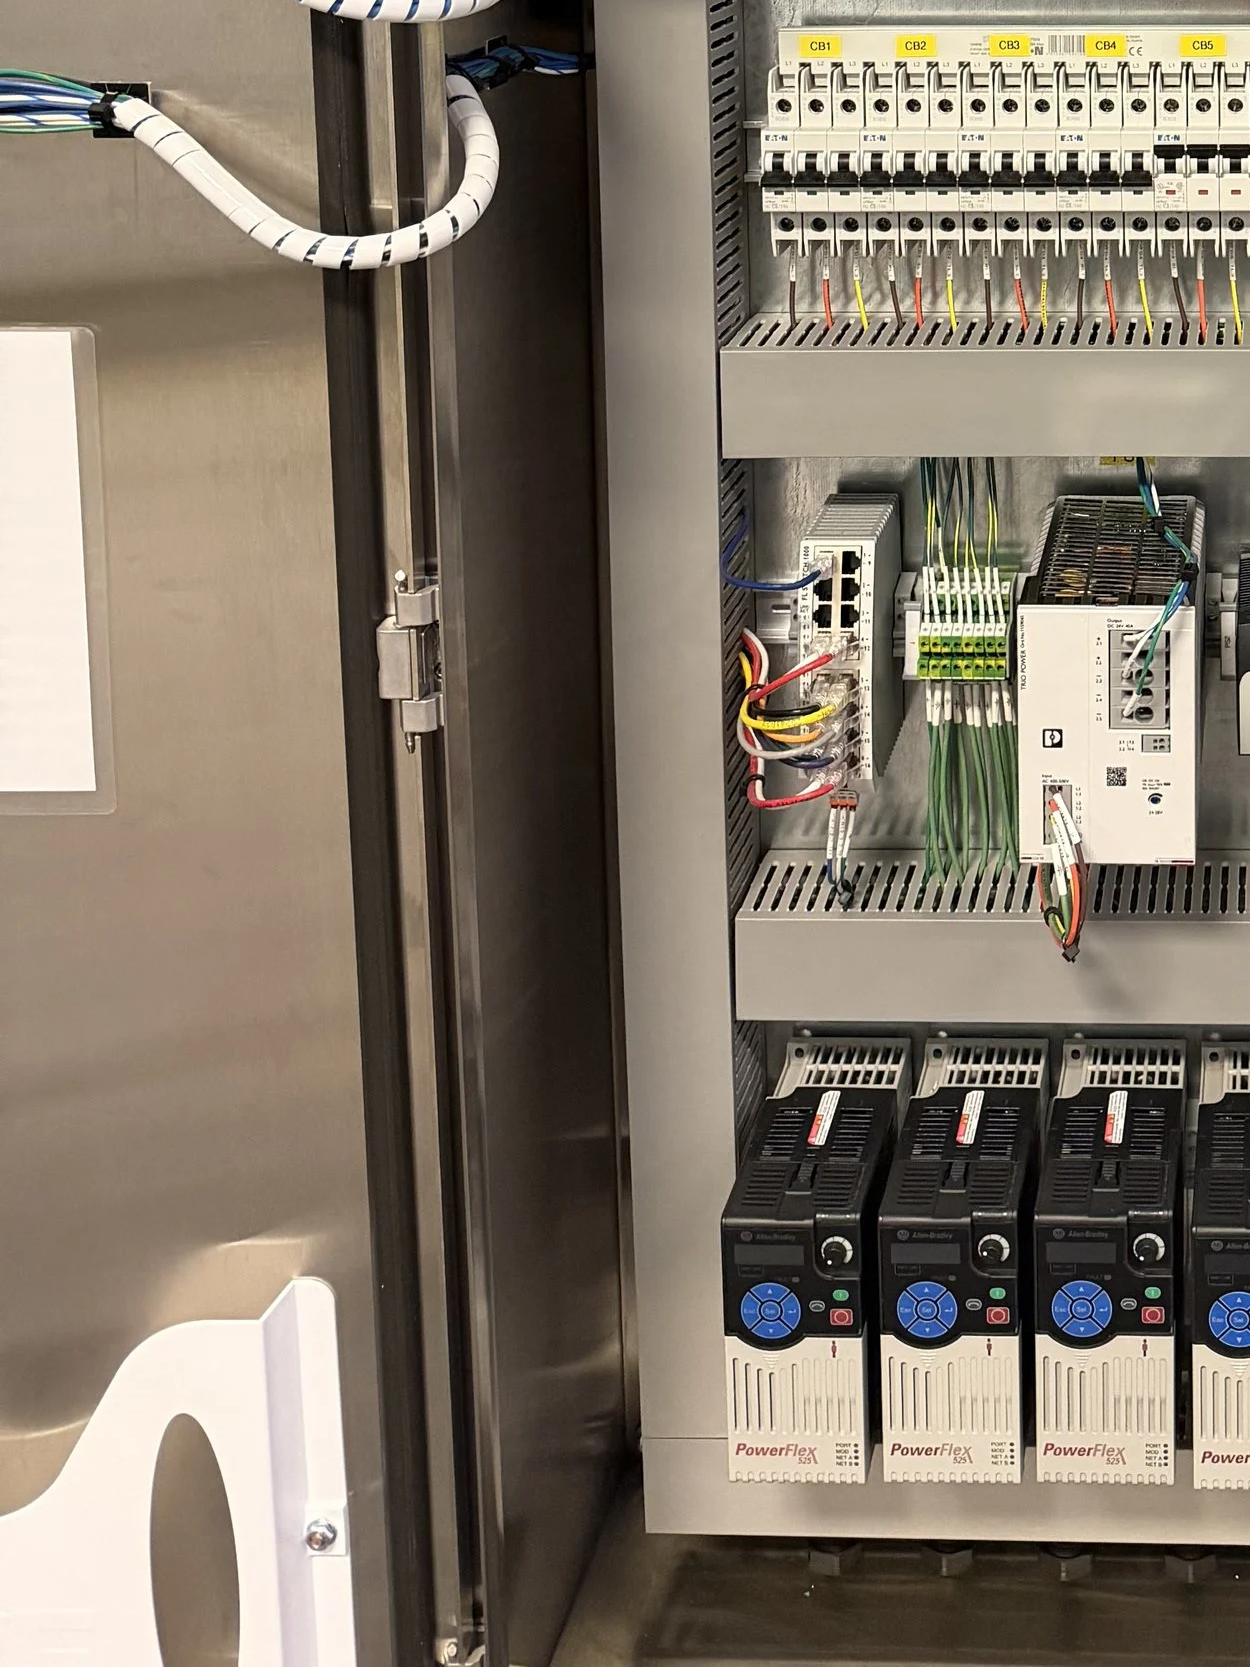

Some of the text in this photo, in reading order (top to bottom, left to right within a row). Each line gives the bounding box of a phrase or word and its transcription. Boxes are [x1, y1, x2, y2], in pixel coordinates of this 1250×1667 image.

[810, 41, 831, 51] CB1
[905, 40, 927, 50] CB2
[998, 40, 1020, 50] CB3
[1095, 40, 1117, 51] CB4
[1192, 40, 1214, 50] CB5
[735, 1443, 818, 1464] PowerFlex
[890, 1443, 973, 1464] PowerFlex
[1043, 1443, 1127, 1465] PowerFlex
[1105, 1457, 1120, 1465] 525
